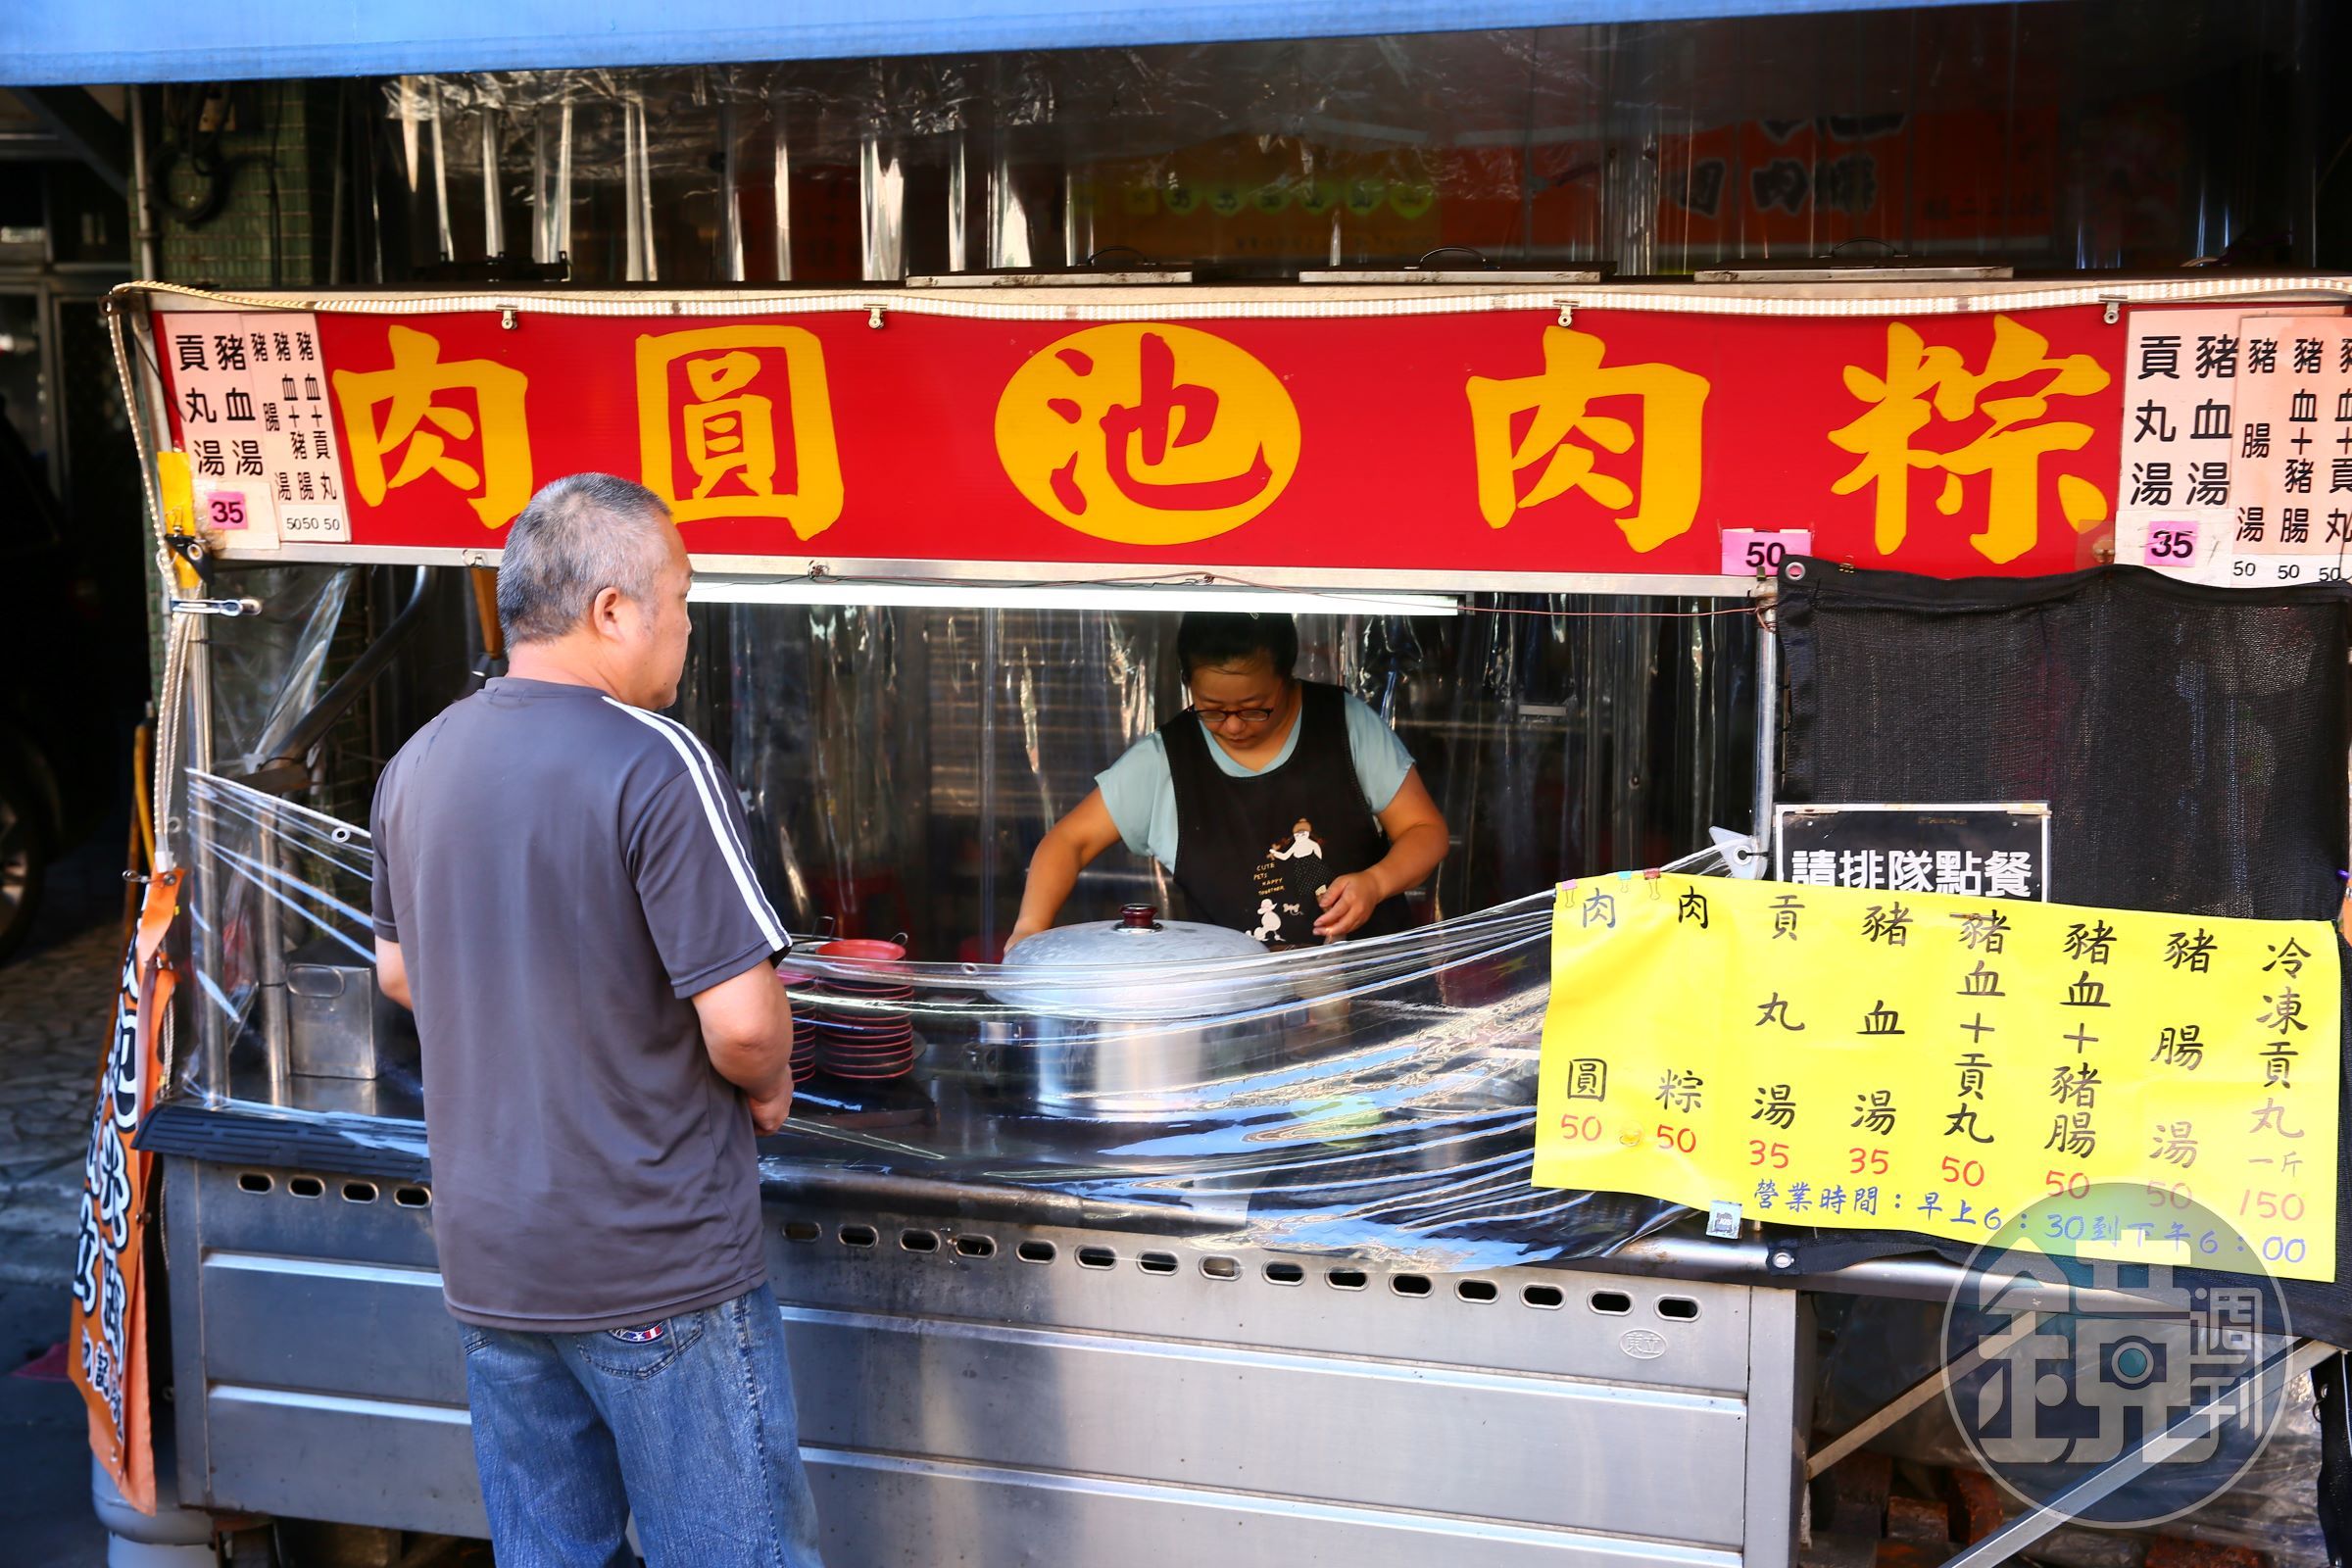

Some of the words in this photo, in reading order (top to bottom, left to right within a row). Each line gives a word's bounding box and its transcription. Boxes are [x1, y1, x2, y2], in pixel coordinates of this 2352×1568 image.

[214, 333, 265, 476] 豬血湯
[2186, 333, 2239, 506] 豬血湯
[175, 334, 225, 476] 貢丸湯
[211, 502, 244, 524] 35
[2130, 335, 2182, 506] 貢丸湯
[330, 323, 845, 542] 肉圓
[1048, 331, 1273, 516] 池
[1465, 314, 2111, 564] 肉粽
[2235, 337, 2278, 543] 豬腸湯
[286, 517, 302, 530] 50
[302, 517, 319, 530] 50
[324, 518, 340, 531] 50
[1745, 542, 1787, 567] 50
[2150, 530, 2193, 559] 35
[2232, 562, 2257, 577] 50
[2278, 564, 2301, 579] 50
[2319, 567, 2340, 582] 50
[1253, 872, 1267, 881] PETS
[1256, 861, 1275, 872] CUTE
[1791, 849, 2032, 898] 請排隊點餐
[1567, 887, 1617, 1103] 肉圓
[1654, 885, 1709, 1113] 肉粽
[1750, 894, 1806, 1130] 貢丸湯
[1849, 901, 1914, 1136] 豬血湯
[2147, 928, 2218, 1170] 豬腸湯
[1560, 1113, 1602, 1143] 50
[1656, 1124, 1697, 1153] 50
[1749, 1140, 1789, 1169] 35
[1848, 1148, 1890, 1175] 35
[1940, 1155, 1984, 1187] 50
[2044, 1169, 2090, 1200] 50
[2146, 1180, 2193, 1210] 50
[2239, 1189, 2305, 1222] 150
